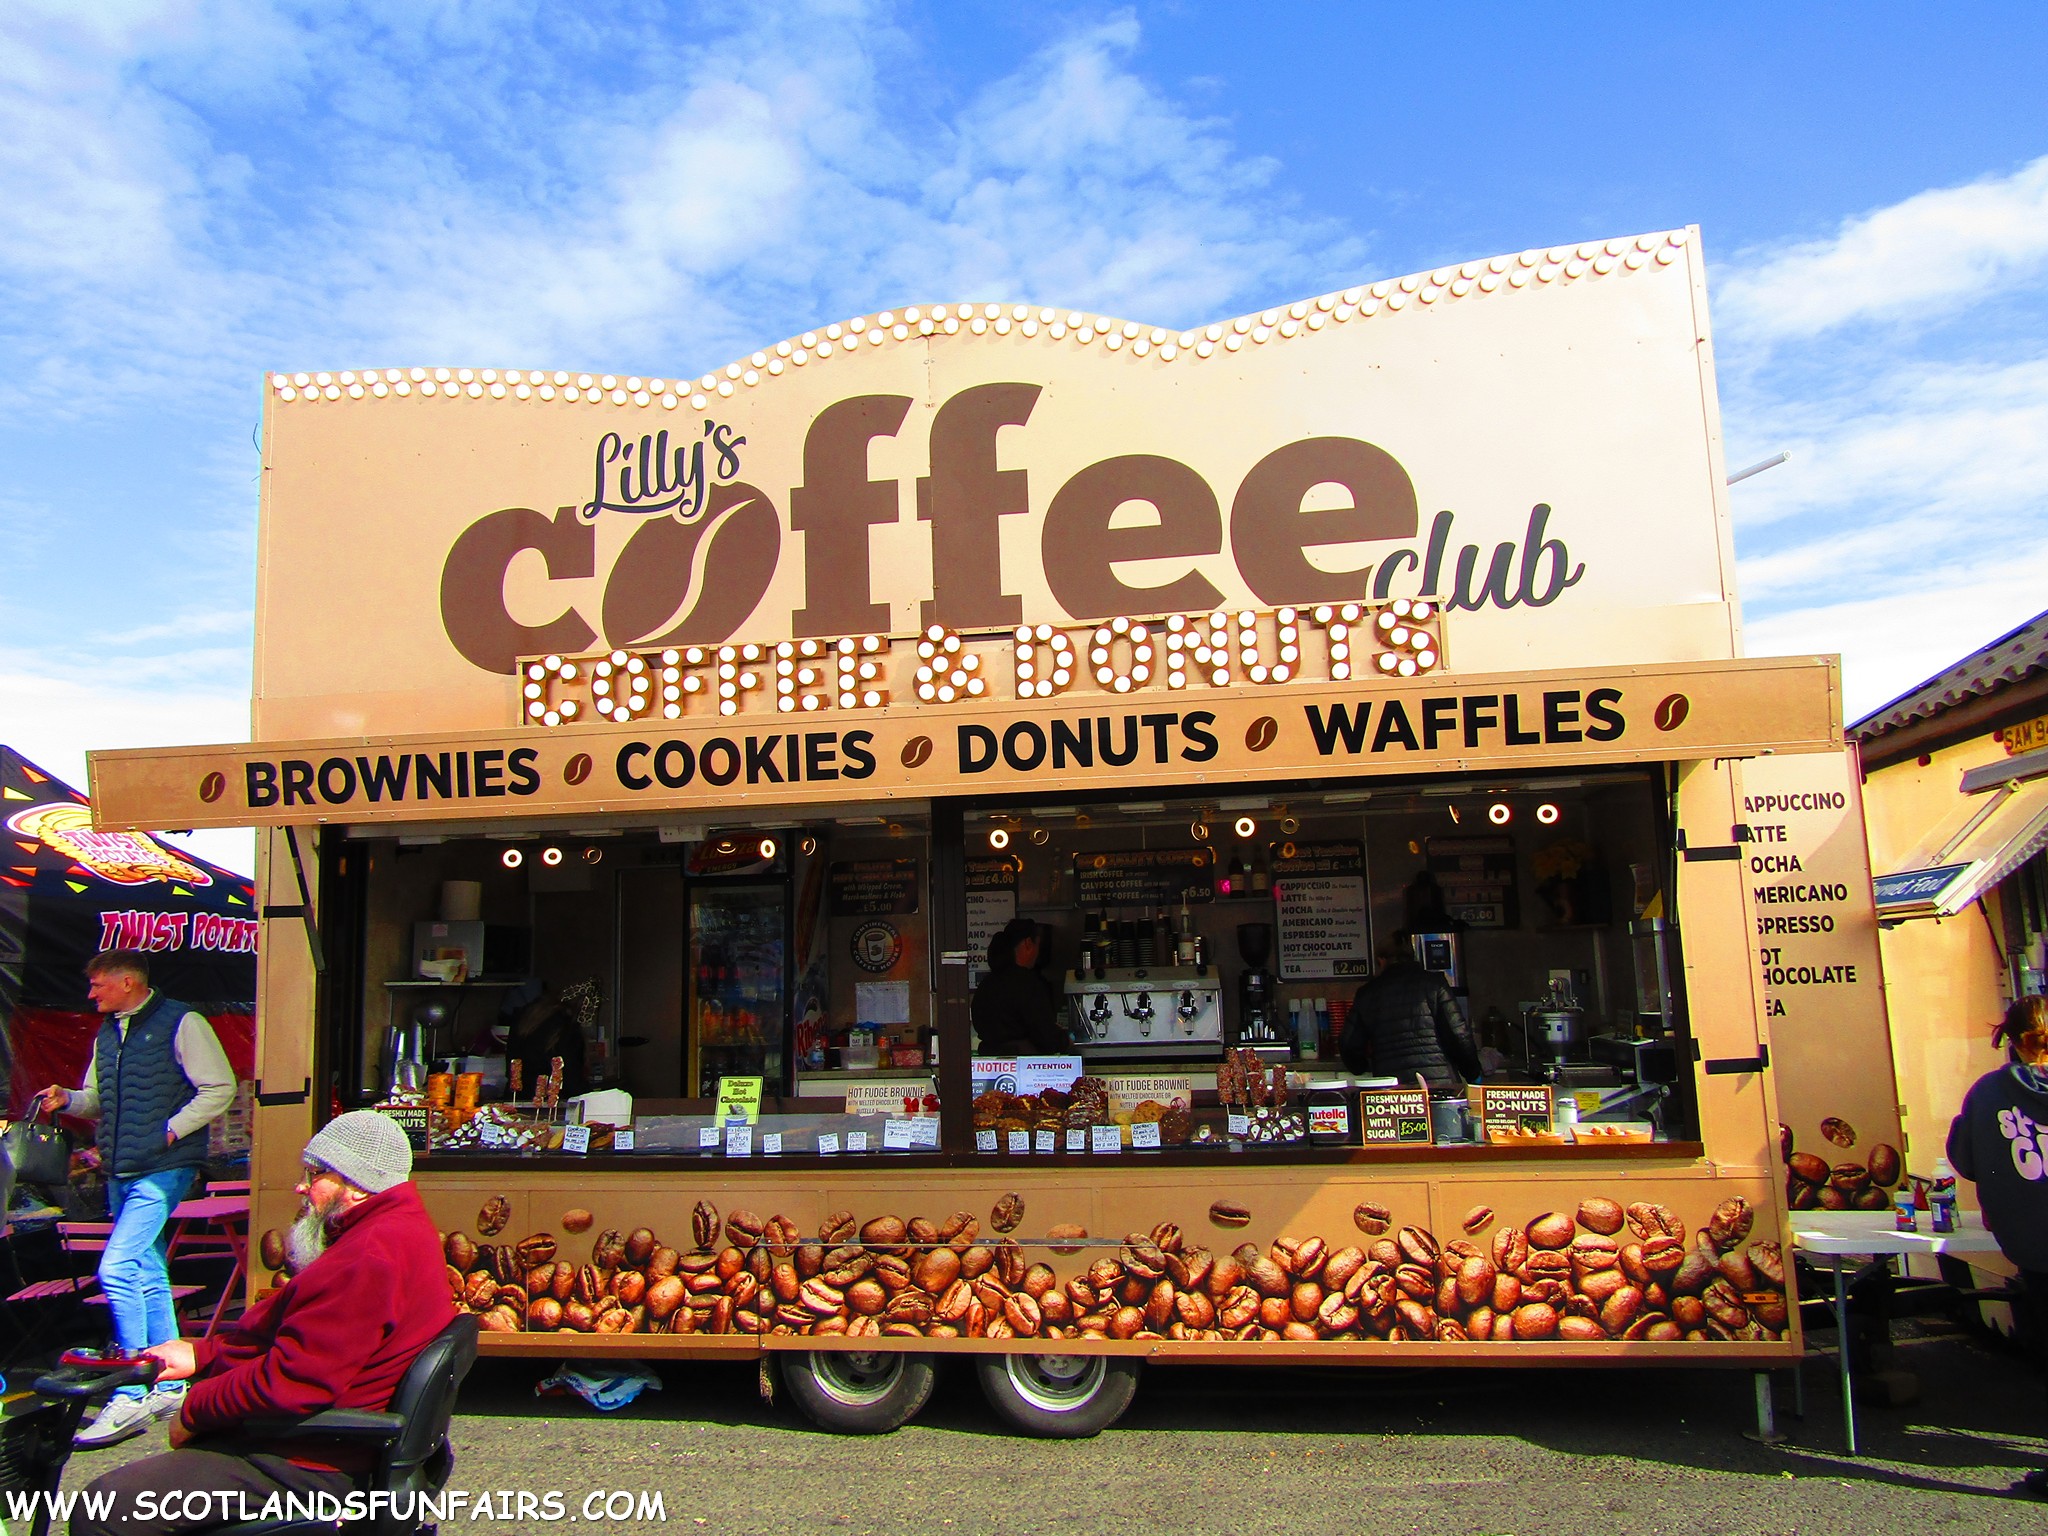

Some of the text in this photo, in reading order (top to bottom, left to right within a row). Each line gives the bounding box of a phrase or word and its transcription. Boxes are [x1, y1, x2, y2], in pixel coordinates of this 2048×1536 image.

[582, 418, 747, 519] Lilly's
[440, 383, 1418, 676] coffee
[1373, 503, 1586, 612] club
[522, 599, 1441, 728] COFFEE & DONUTS
[1303, 687, 1627, 756] WAFFLES
[957, 710, 1219, 775] DONUTS
[615, 730, 877, 790] COOKIES
[245, 747, 540, 809] BROWNIES
[1745, 791, 1845, 814] APPUCCINO
[1746, 825, 1787, 843] ATTE
[61, 830, 147, 852] TWIST
[1750, 854, 1802, 874] OCHA
[1100, 870, 1124, 878] COFFEE
[1116, 879, 1143, 888] COFFEE
[1280, 881, 1331, 891] CAPPUCCINO
[1280, 894, 1307, 903] LATTE
[1754, 883, 1848, 905] MERICANO
[1281, 906, 1313, 915] MOCHA
[1282, 917, 1334, 928] AMERICANO
[1756, 915, 1834, 936] SPRESSO
[99, 910, 188, 954] TWIST
[191, 912, 258, 955] POTAT
[1282, 930, 1327, 940] ESPRESSO
[1284, 942, 1353, 952] HOT CHOCOLATE
[1760, 947, 1781, 967] OT
[1334, 962, 1366, 974] £2.00
[1762, 965, 1857, 986] HOCOLATE
[1765, 998, 1786, 1017] EA
[977, 1062, 1017, 1072] NOTICE
[1000, 1082, 1014, 1094] £5
[1110, 1079, 1190, 1091] HOT FUDGE BROWNIE
[848, 1086, 924, 1098] HOT FUDGE BROWNIE
[1486, 1090, 1546, 1100] FRESHLY MADE
[1366, 1094, 1424, 1104] FRESHLY MADE
[1366, 1104, 1426, 1116] DO-NUTS
[1486, 1100, 1548, 1112] DO-NUTS
[408, 1110, 426, 1118] MADE
[1309, 1108, 1346, 1120] nutella
[398, 1118, 426, 1128] NUTS
[1369, 1118, 1392, 1128] WITH
[1366, 1129, 1396, 1139] SUGAR
